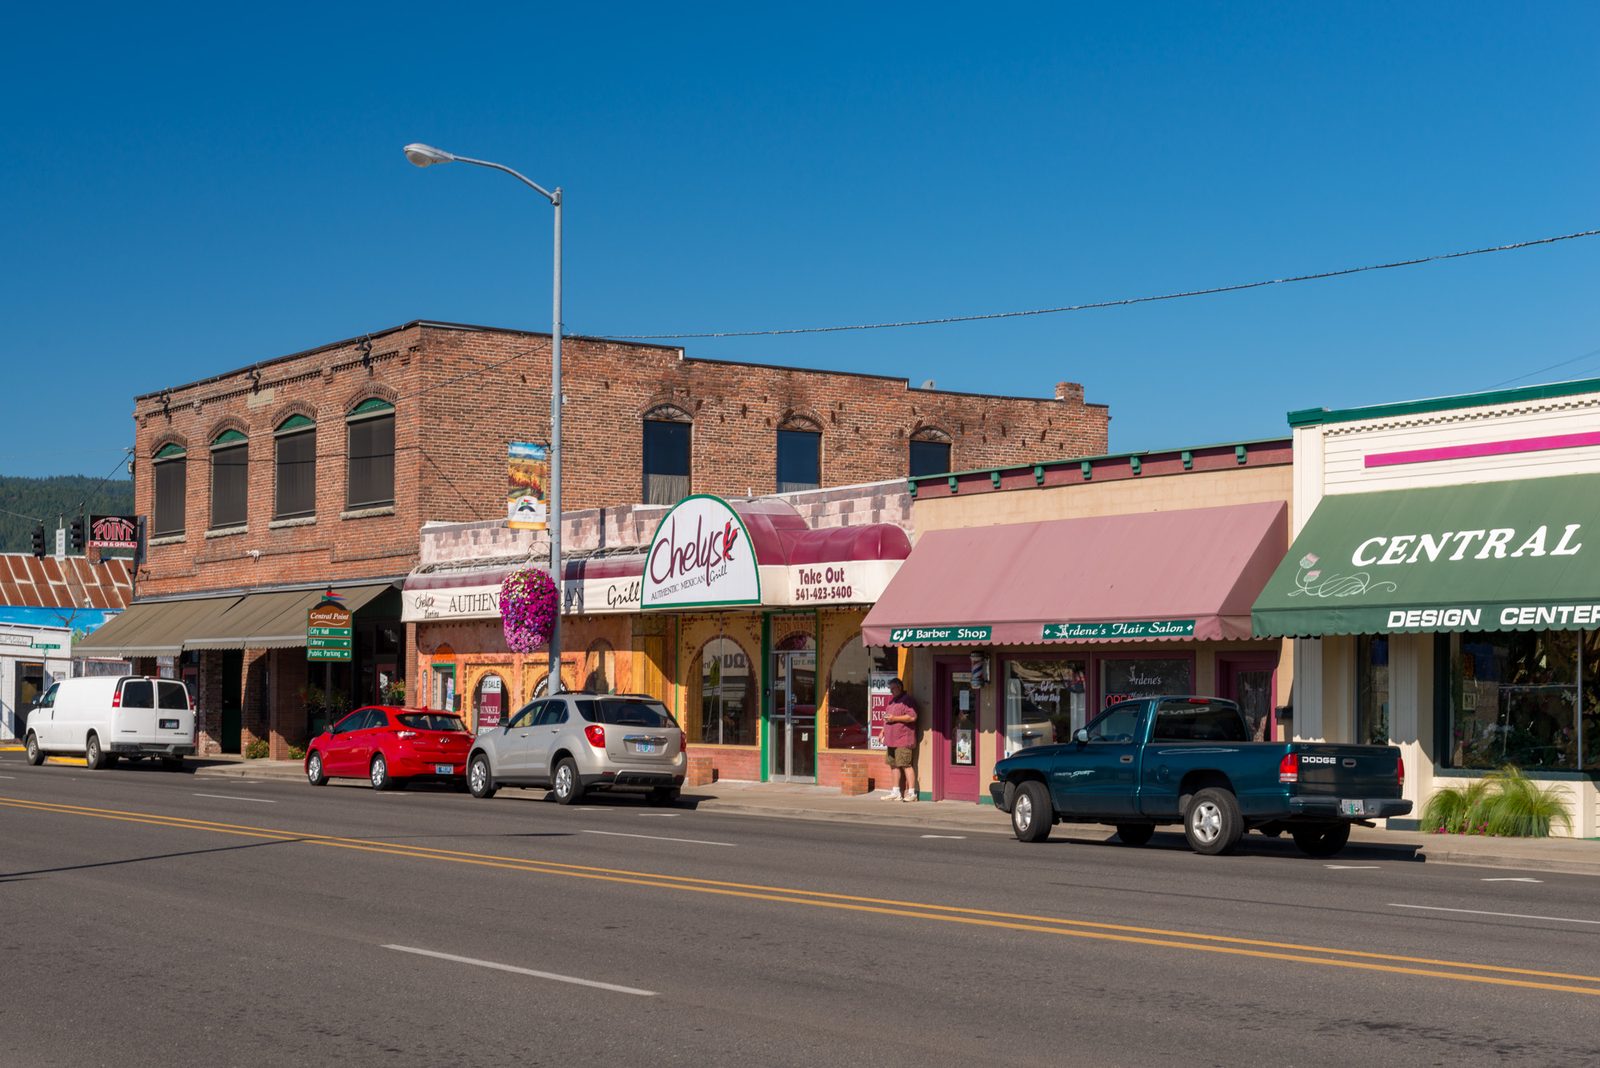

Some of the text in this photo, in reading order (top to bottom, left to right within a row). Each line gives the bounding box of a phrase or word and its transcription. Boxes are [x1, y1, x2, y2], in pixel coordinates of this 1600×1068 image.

[94, 522, 133, 540] POINT
[650, 514, 723, 586] Chelys
[1351, 524, 1582, 567] CENTRAL
[799, 567, 845, 585] Take Out
[608, 582, 640, 609] Grill
[651, 584, 680, 600] AUTHENTIC
[681, 574, 706, 590] MEXICAN
[449, 593, 500, 612] AUTHEN
[1387, 609, 1481, 628] DESIGN
[893, 629, 987, 642] CJ's Barber Shop
[1112, 623, 1145, 635] Hair
[1149, 622, 1183, 633] Salon
[873, 680, 886, 688] FOR
[873, 697, 885, 708] JIM
[1105, 695, 1134, 709] OP
